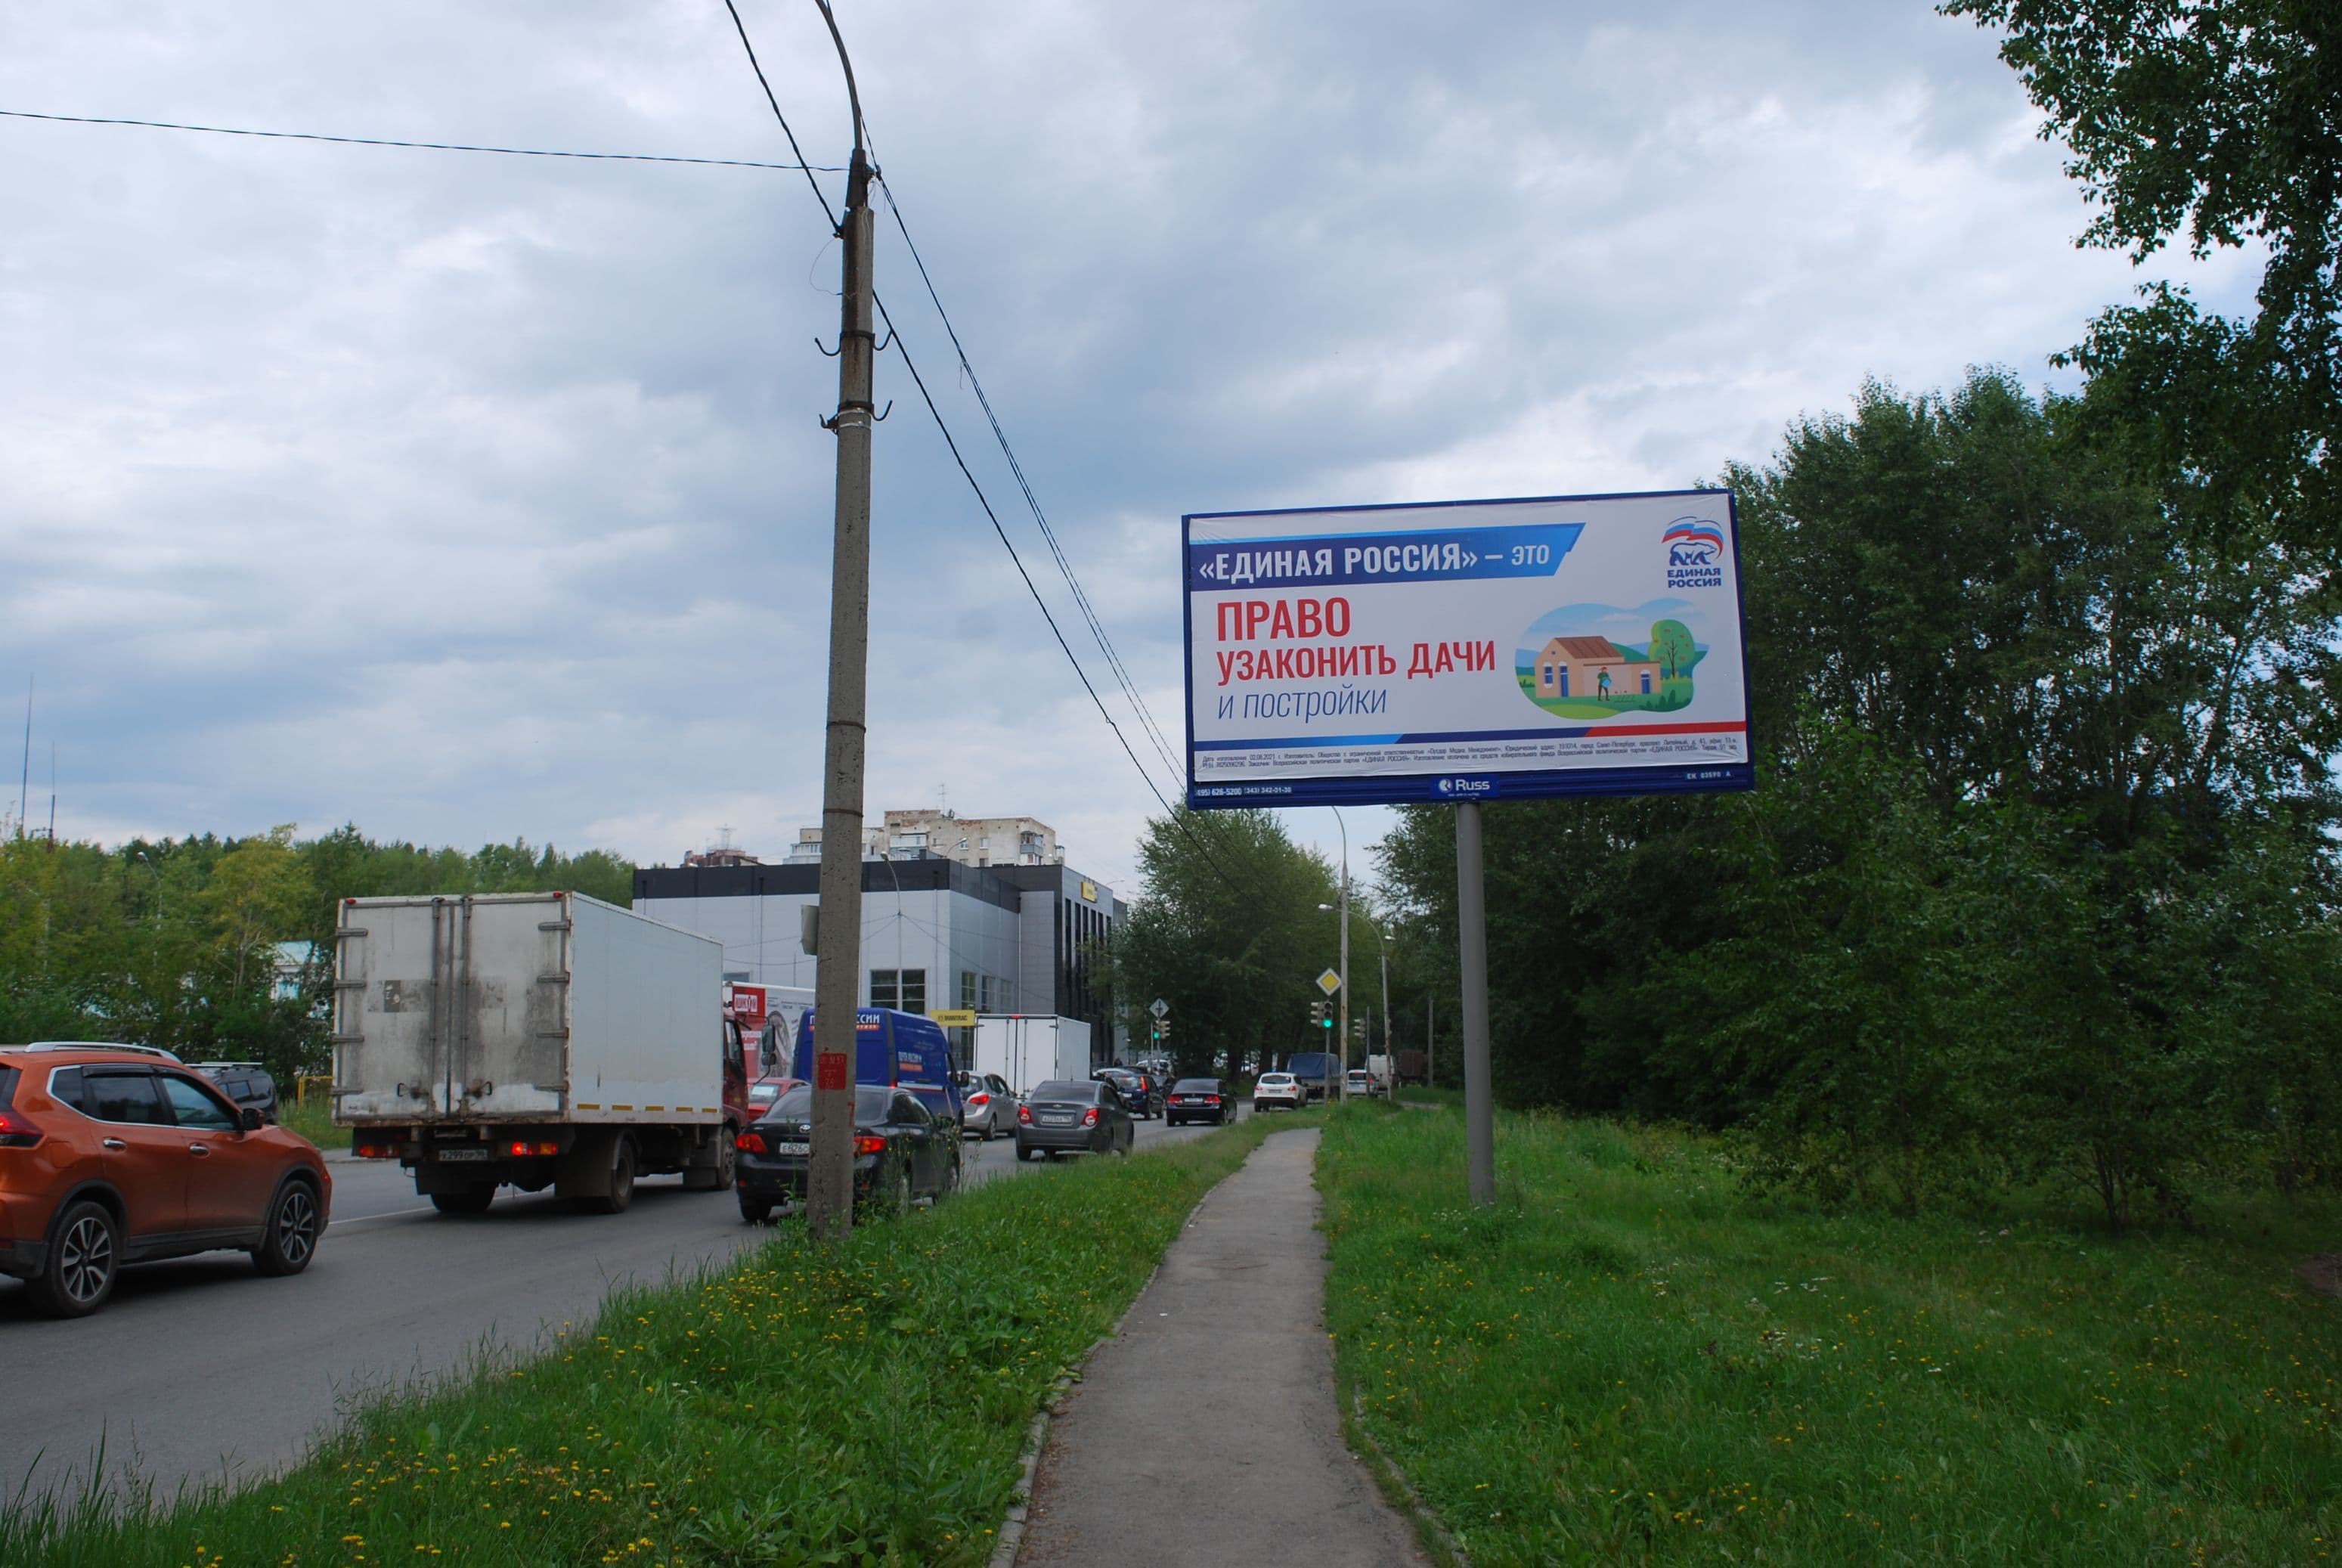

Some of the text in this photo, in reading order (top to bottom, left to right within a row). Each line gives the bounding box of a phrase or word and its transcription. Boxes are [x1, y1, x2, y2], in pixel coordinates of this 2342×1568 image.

[1199, 549, 1333, 584] «ЕДИНАЯ
[1344, 543, 1478, 575] РОССИЯ»
[1511, 544, 1550, 566] ЭТО
[1667, 568, 1721, 578] ЕДИНАЯ
[1668, 578, 1722, 588] РОССИЯ
[1216, 597, 1351, 641] ПРАВО
[1216, 640, 1495, 686] УЗАКОНИТЬ ДАЧИ
[1244, 683, 1386, 724] постройки
[1455, 779, 1490, 791] Russ
